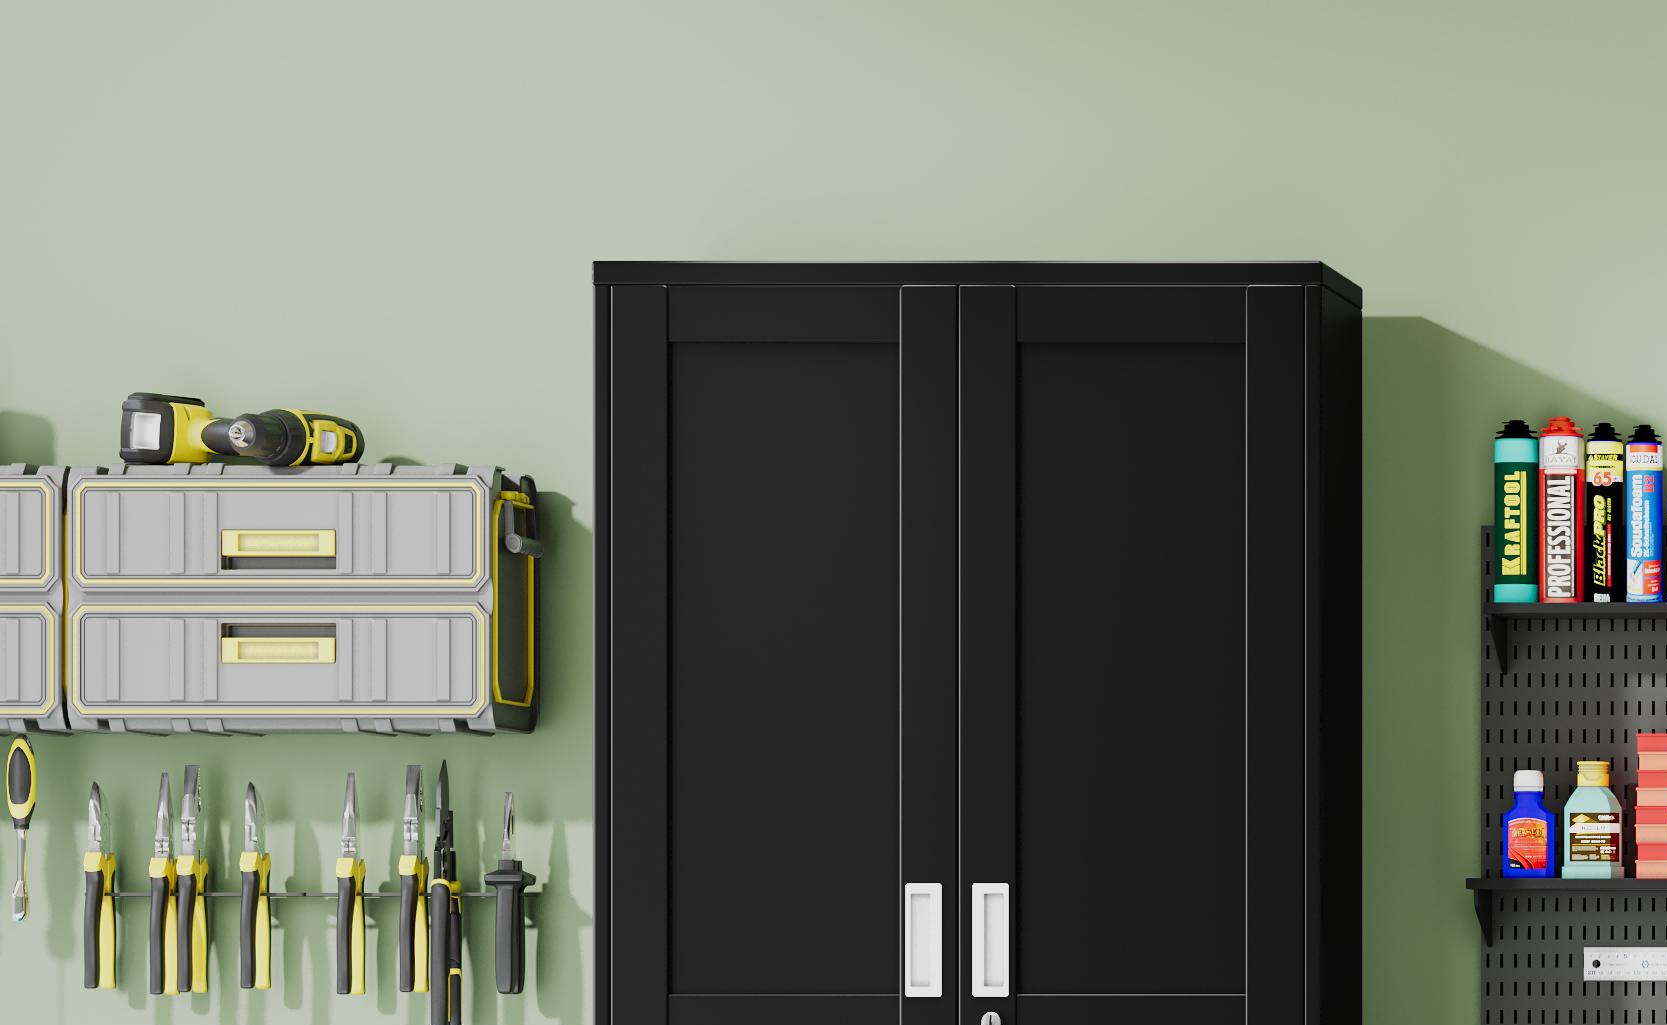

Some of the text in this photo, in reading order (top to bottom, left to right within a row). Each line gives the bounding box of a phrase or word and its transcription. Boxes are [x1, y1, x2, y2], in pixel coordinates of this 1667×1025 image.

[1501, 470, 1521, 576] KRAFTOOL
[1546, 475, 1571, 598] PROFESSIONAL
[1631, 474, 1644, 558] Soudafoam
